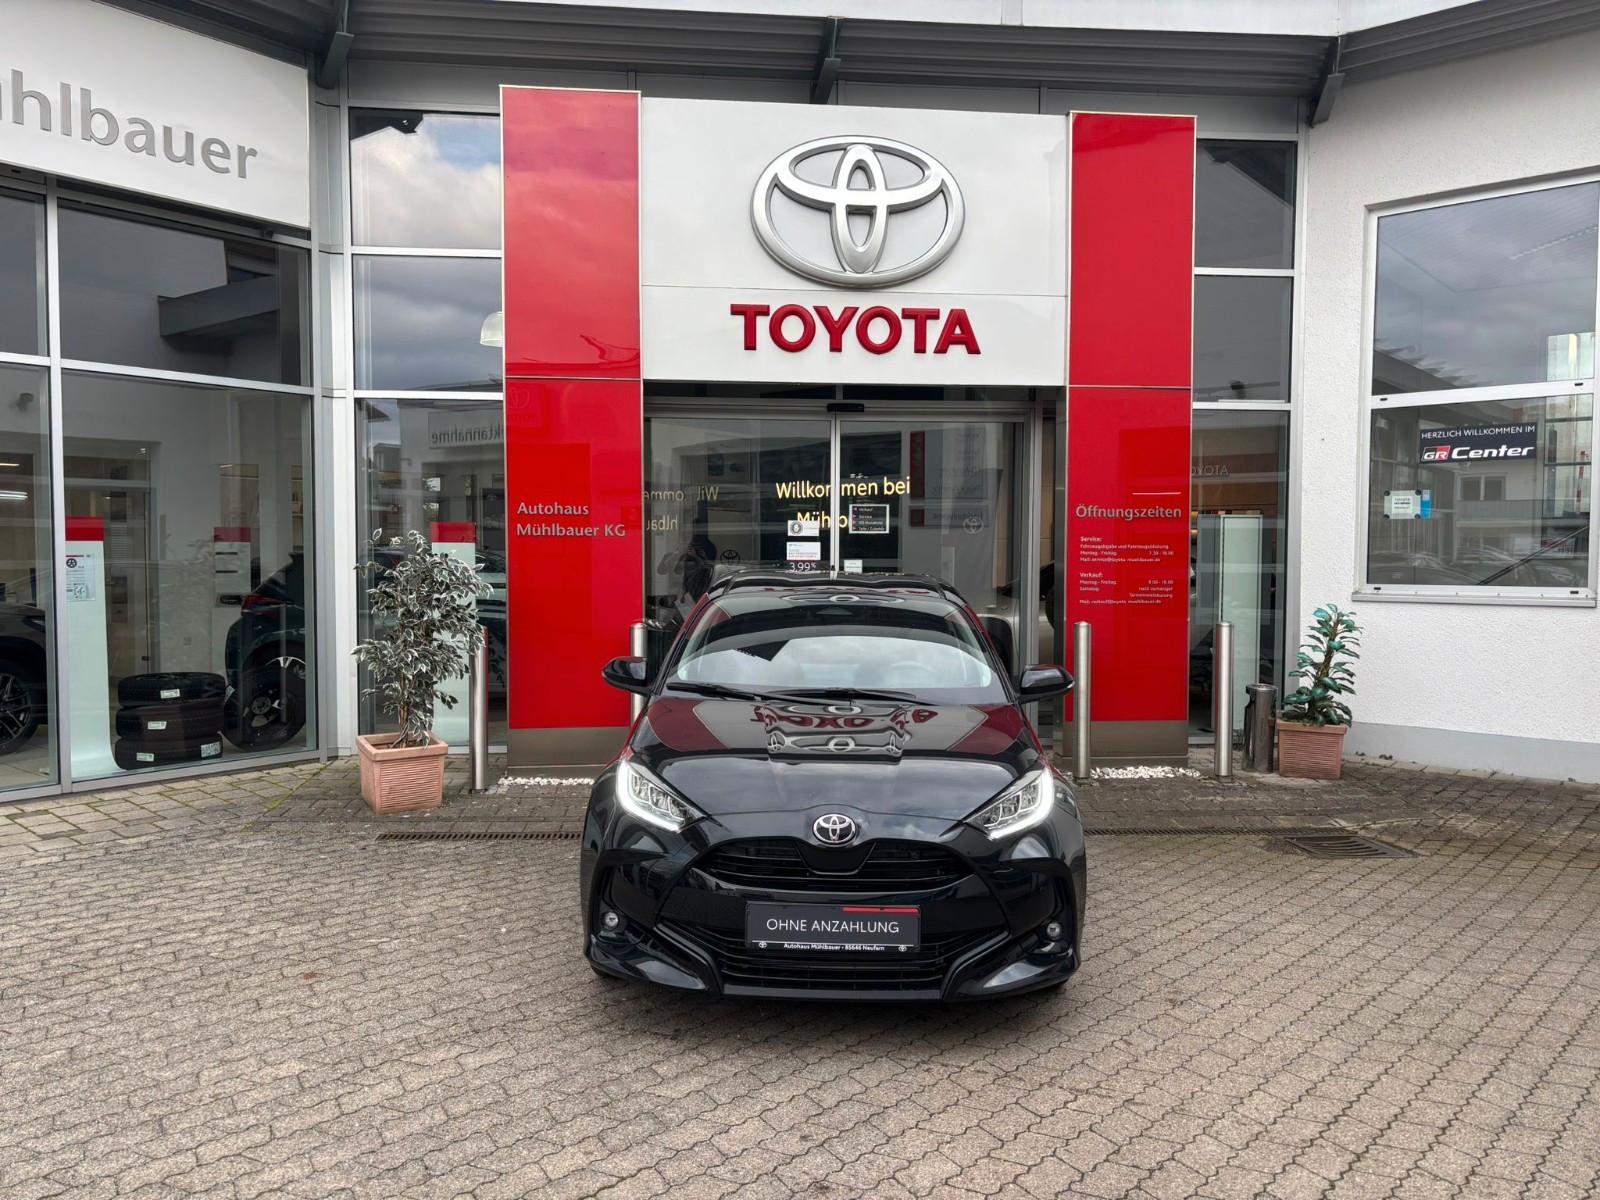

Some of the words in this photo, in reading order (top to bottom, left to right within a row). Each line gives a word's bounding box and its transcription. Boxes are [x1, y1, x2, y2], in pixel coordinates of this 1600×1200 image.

[0, 68, 258, 179] hlbauer
[730, 303, 981, 355] TOYOTA
[1421, 430, 1462, 439] HERZLICH
[1463, 426, 1523, 437] WILLKOMMEN
[1525, 425, 1536, 433] IM
[1423, 451, 1449, 460] GR
[1451, 445, 1535, 459] Center
[883, 476, 911, 495] bei
[517, 502, 589, 515] Autohaus
[1075, 504, 1182, 520] Öffnungszeiten
[517, 524, 599, 536] Mühlbauer
[604, 524, 626, 536] KG
[766, 918, 807, 932] OHNE
[811, 920, 900, 933] ANZAHLUNG
